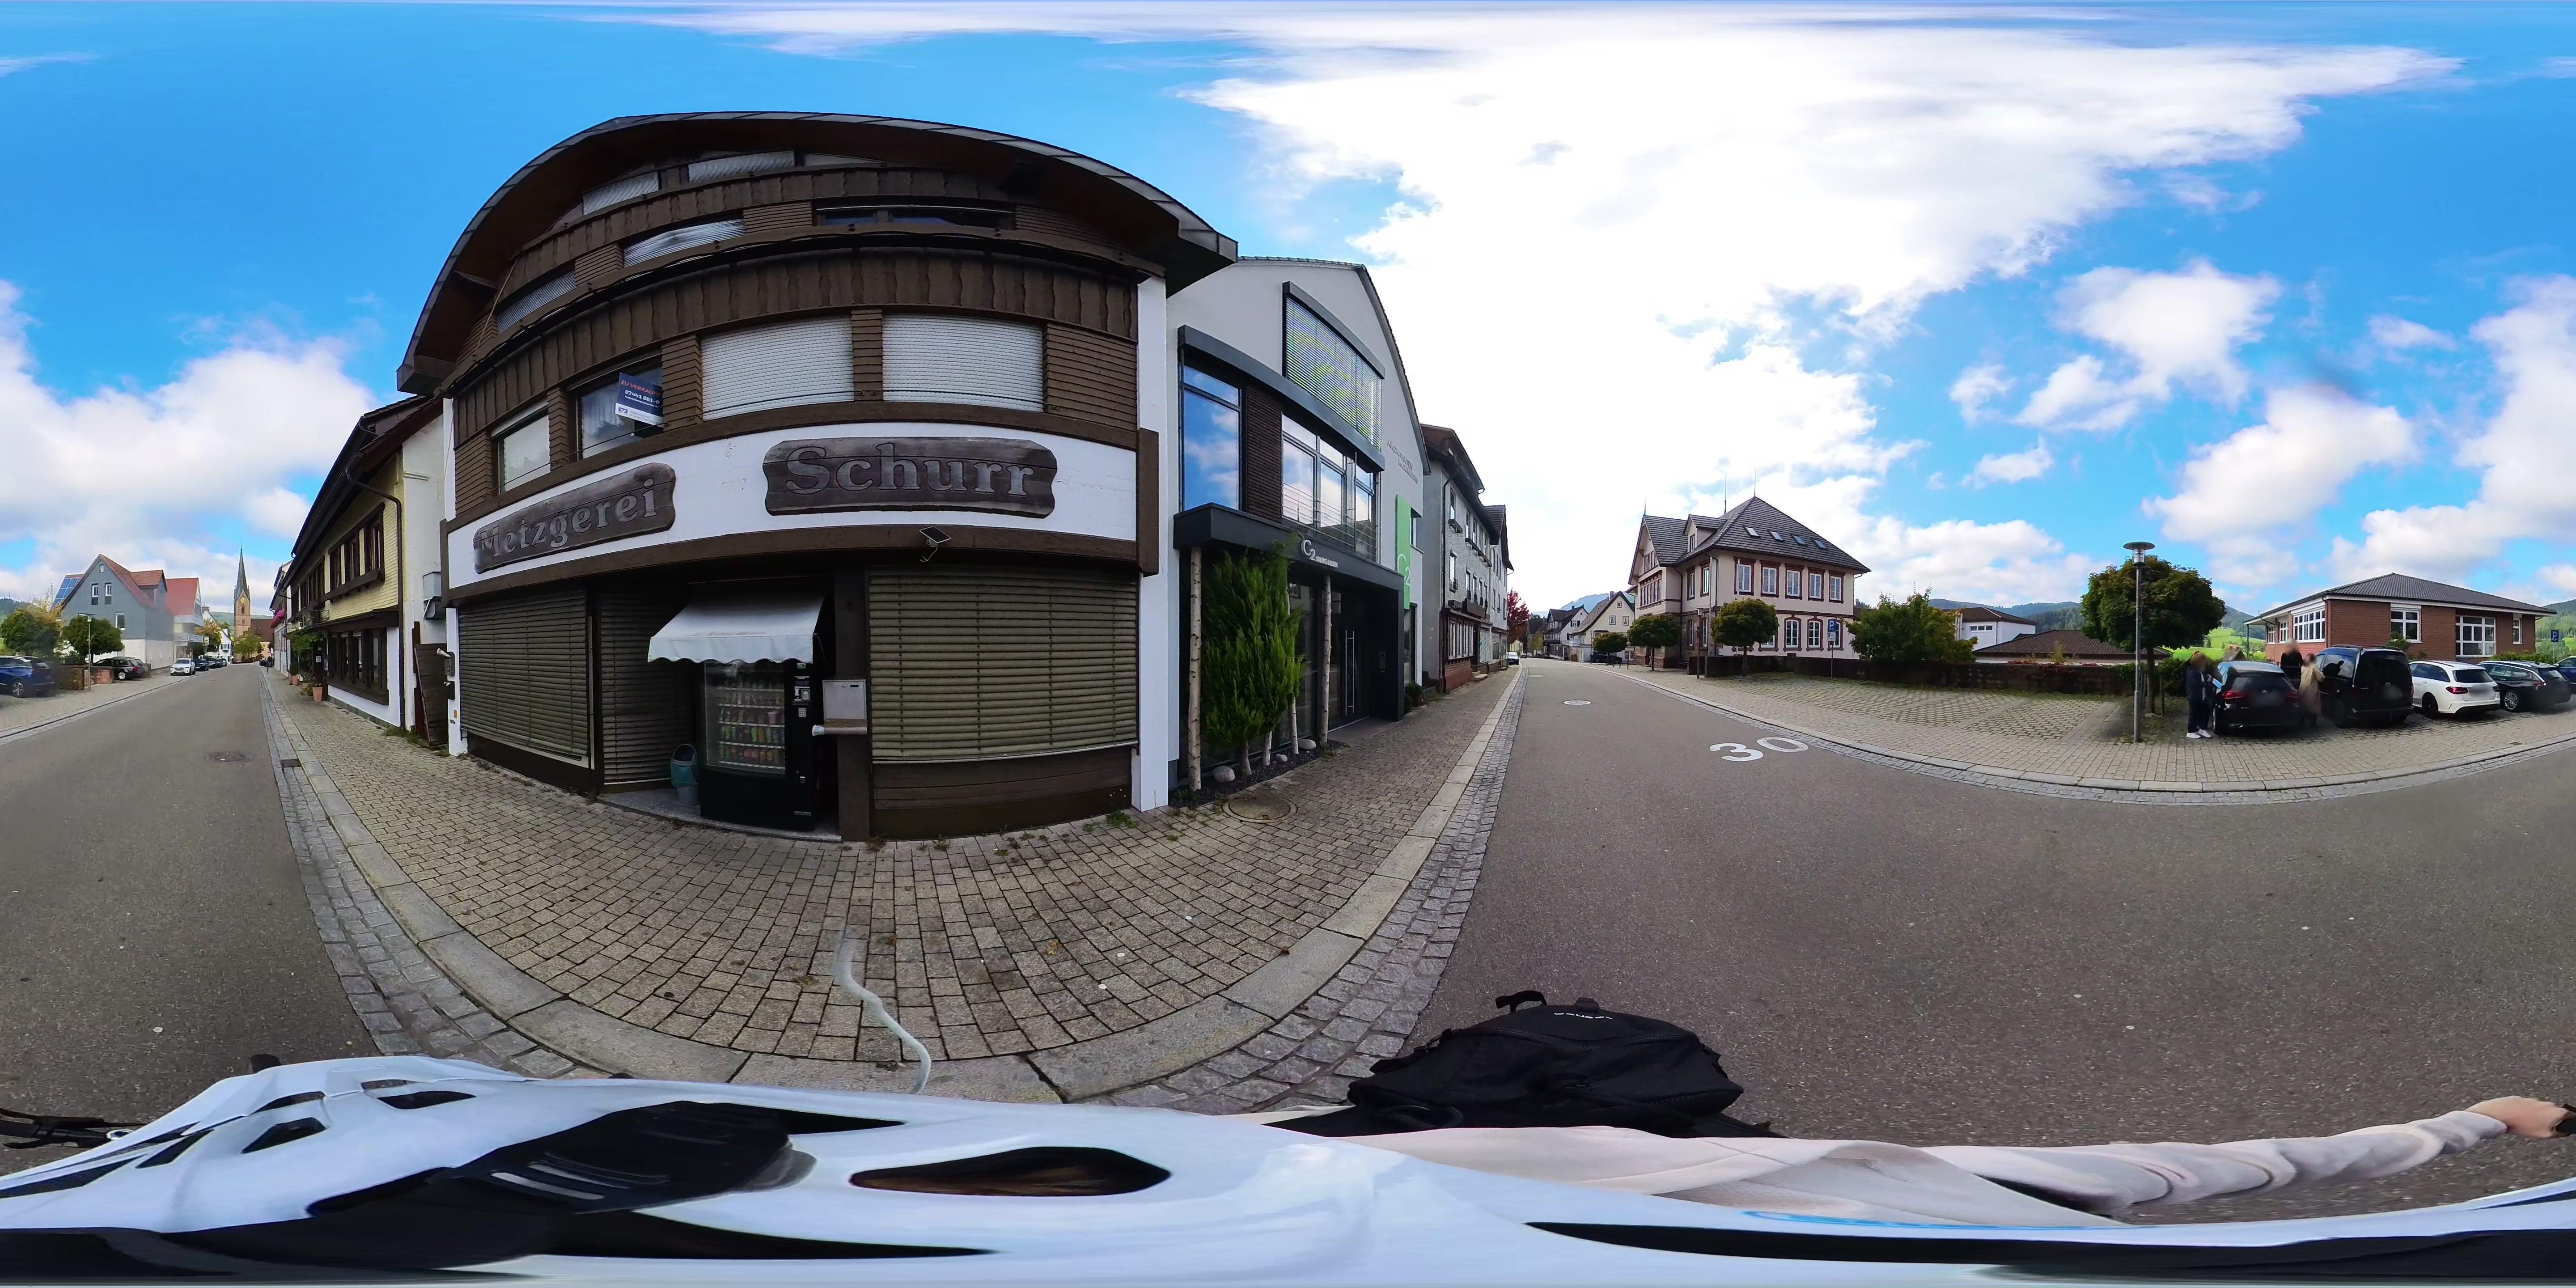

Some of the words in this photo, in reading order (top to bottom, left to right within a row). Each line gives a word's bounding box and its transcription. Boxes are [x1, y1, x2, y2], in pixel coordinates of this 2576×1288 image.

[625, 390, 642, 399] 07441
[643, 395, 660, 404] 861-0
[785, 442, 1034, 496] Schurr
[479, 479, 657, 558] Metzgerei
[1709, 737, 1809, 762] 30
